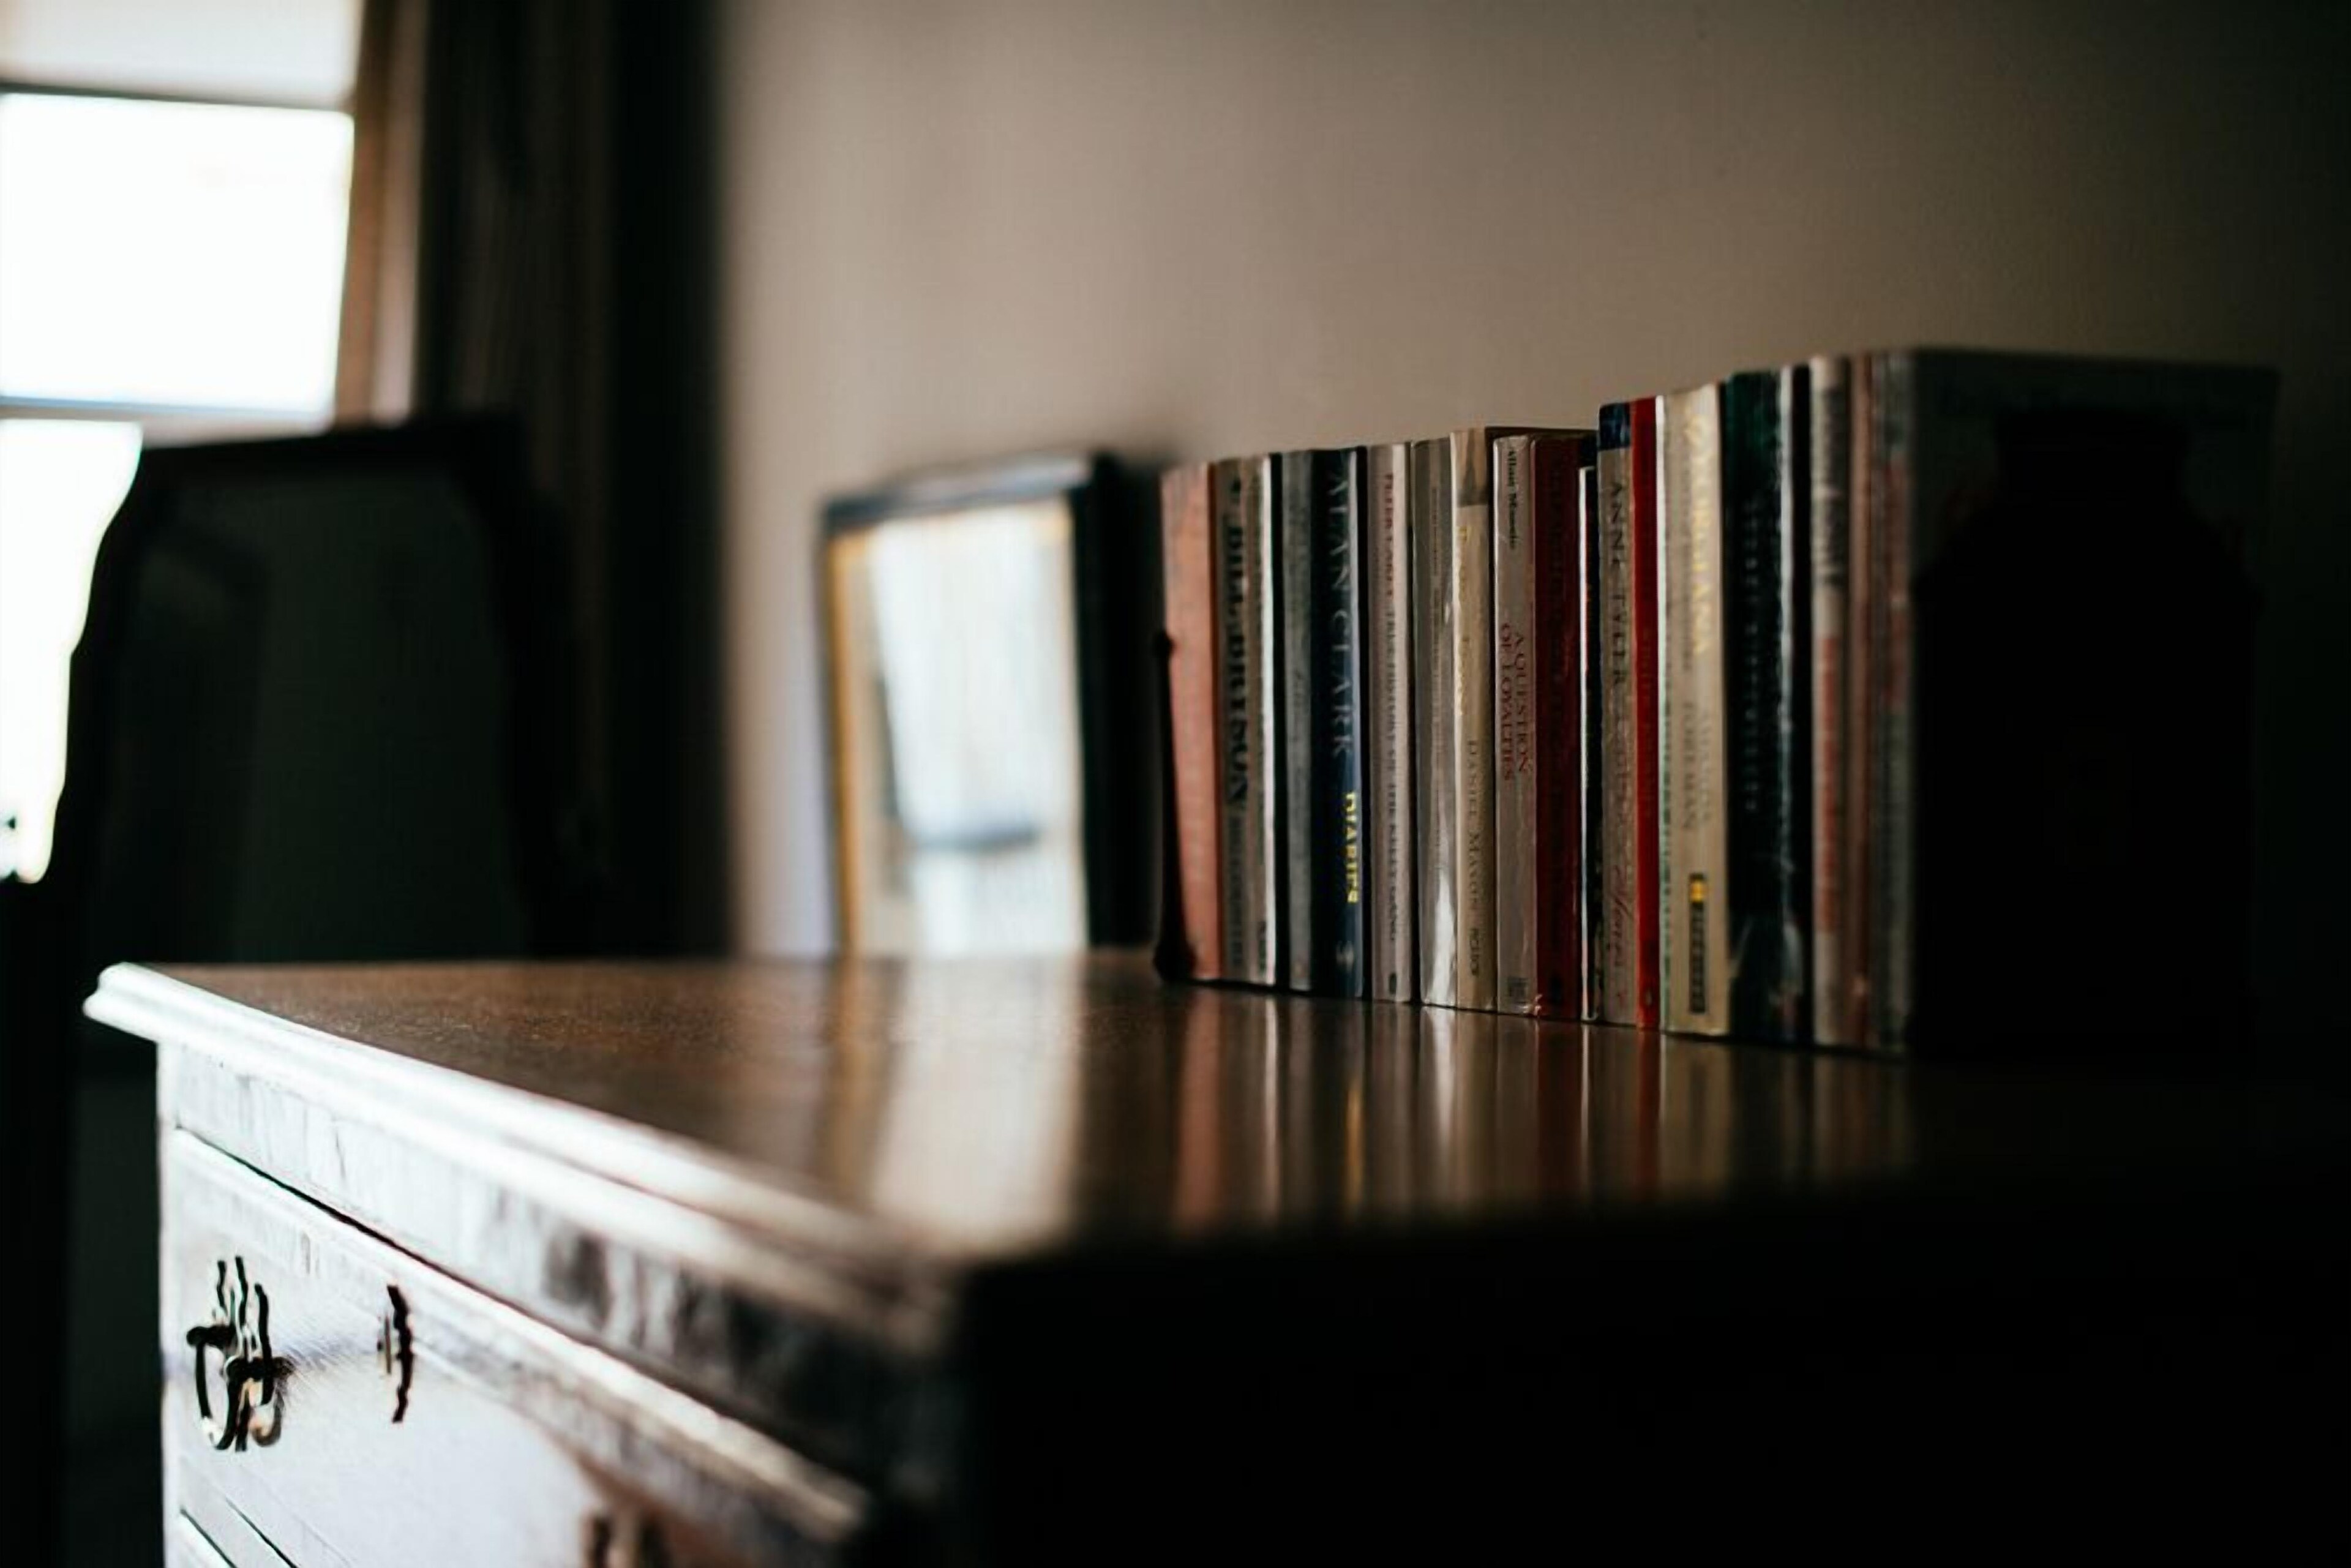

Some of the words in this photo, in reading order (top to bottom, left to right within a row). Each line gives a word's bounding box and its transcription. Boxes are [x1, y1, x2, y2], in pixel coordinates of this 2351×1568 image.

[1327, 473, 1351, 593] ALAN
[1384, 473, 1395, 528] PETER
[1610, 482, 1626, 576] ANNE
[1224, 522, 1245, 618] BILL
[1330, 609, 1355, 758] CLARK
[1501, 623, 1512, 653] OF
[1515, 633, 1526, 645] A
[1611, 589, 1629, 688] TYLER
[1225, 628, 1248, 806] BRYSON
[1501, 664, 1516, 781] LOYALTIES
[1514, 653, 1533, 773] QUESTION
[1344, 791, 1360, 904] DIARIES
